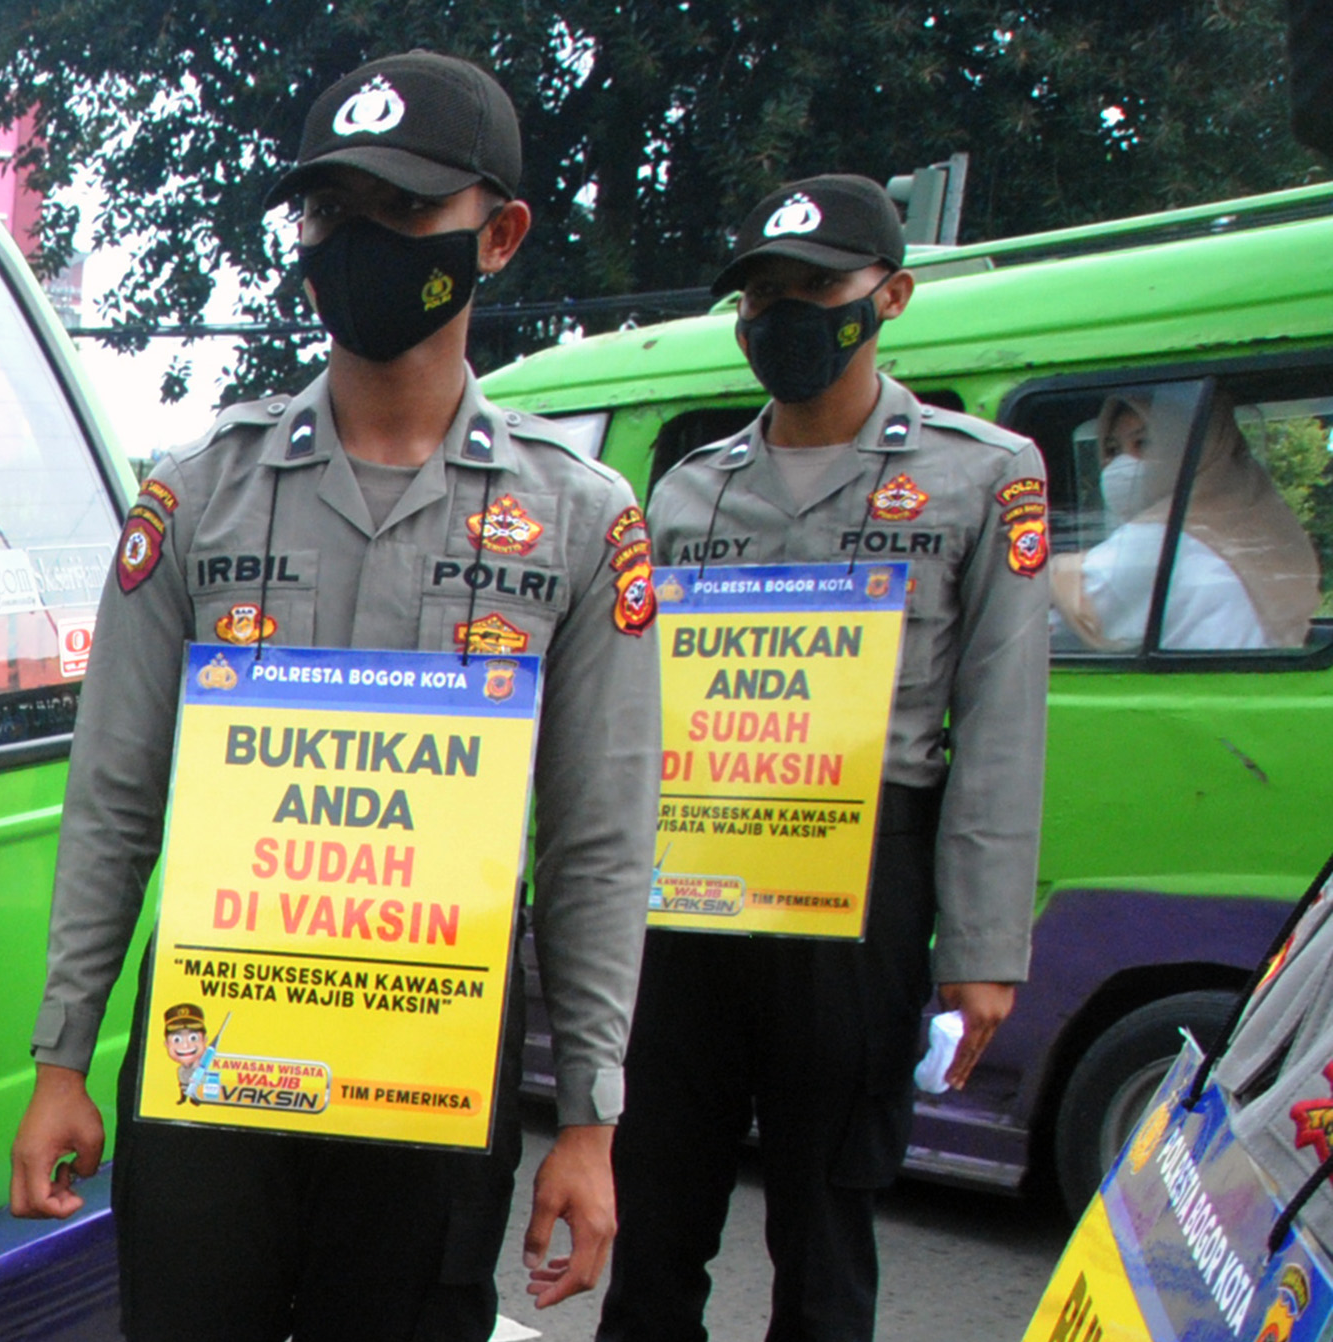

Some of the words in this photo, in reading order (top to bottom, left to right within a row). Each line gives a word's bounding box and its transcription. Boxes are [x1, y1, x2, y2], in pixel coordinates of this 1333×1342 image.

[1002, 480, 1041, 502] POLDA
[678, 536, 751, 565] AUDY
[840, 530, 942, 554] POLRI
[198, 556, 299, 587] IRBIL
[433, 561, 559, 602] POLRI
[693, 577, 761, 594] POLRESTA
[764, 578, 816, 593] BOGOR
[818, 577, 854, 592] KOTA
[671, 625, 863, 658] BUKTIKAN
[252, 664, 343, 685] POLRESTA
[349, 668, 416, 688] BOGOR
[421, 670, 468, 690] KOTA
[705, 668, 811, 701] ANDA
[688, 709, 811, 743] SUDAH
[224, 724, 481, 777] BUKTIKAN
[661, 750, 693, 782] DI
[708, 752, 844, 786] VAKSIN
[272, 783, 415, 831] ANDA
[680, 805, 773, 821] SUKSESKAN
[778, 808, 861, 825] KAWASAN
[712, 821, 763, 836] WAJIB
[251, 836, 416, 888] SUDAH
[662, 897, 735, 912] VAKSIN
[674, 887, 722, 899] WAJIB
[752, 892, 773, 905] TIM
[777, 894, 851, 909] PEMERIKSA
[212, 889, 259, 931] DI
[278, 892, 461, 946] VAKSIN
[200, 979, 277, 1002] WISATA
[286, 985, 355, 1008] WAJIB
[243, 963, 368, 990] SUKSESKAN
[374, 973, 484, 999] KAWASAN
[213, 1058, 274, 1074] KAWASAN
[277, 1062, 324, 1078] WISATA
[236, 1071, 302, 1090] WAJIB
[221, 1086, 319, 1109] VAKSIN
[341, 1084, 370, 1101] TIM
[374, 1087, 472, 1110] PEMERIKSA
[1156, 1126, 1201, 1225] POLRESTA
[1183, 1191, 1228, 1285] BOGOR
[1211, 1250, 1255, 1337] KOTA
